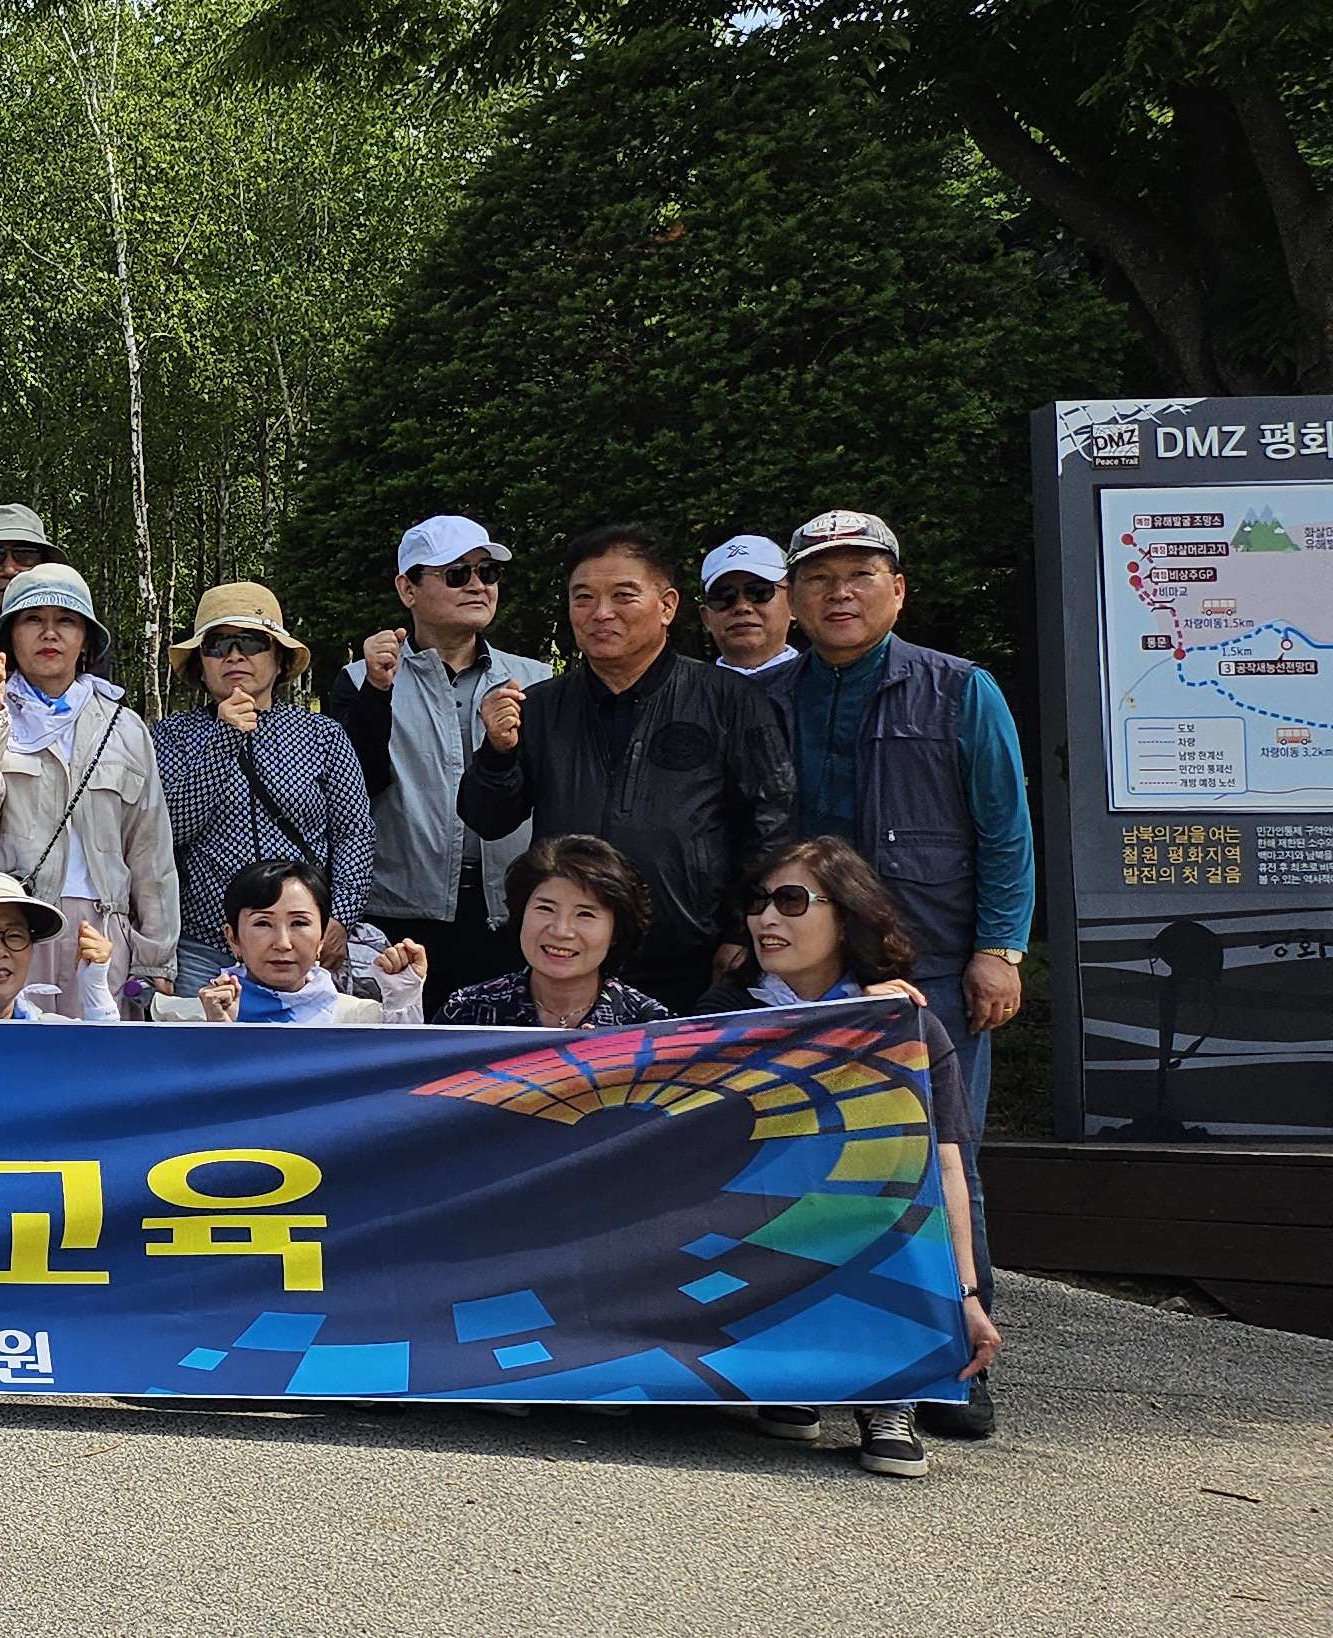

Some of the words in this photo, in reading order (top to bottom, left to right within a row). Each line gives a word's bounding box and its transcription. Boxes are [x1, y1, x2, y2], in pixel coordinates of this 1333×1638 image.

[1093, 428, 1139, 455] DMZ
[1156, 426, 1248, 458] DMZ
[1095, 457, 1119, 466] Peace
[1120, 457, 1138, 465] Trail
[1153, 515, 1191, 527] 유해발굴
[1193, 515, 1222, 526] 조망소
[1168, 544, 1227, 556] 화살머리고지
[1169, 569, 1214, 581] 비상주GP
[1146, 637, 1167, 649] 통문
[1221, 647, 1252, 657] 1.5km
[1224, 663, 1231, 673] 3
[1236, 661, 1316, 674] 공작새능선전망대
[1177, 723, 1195, 733] 도보
[1178, 737, 1196, 747] 차량
[1178, 751, 1196, 761] 남방
[1198, 751, 1224, 761] 한계선
[1260, 746, 1299, 758] 차량이동
[1178, 765, 1204, 775] 민간인
[1179, 778, 1197, 788] 개방
[1198, 778, 1216, 788] 예정
[1218, 778, 1236, 788] 노선
[1122, 825, 1170, 844] 남북의
[1173, 825, 1206, 844] 길을
[1209, 825, 1242, 843] 여는
[1304, 825, 1333, 836] 구역안
[1122, 846, 1158, 864] 철원
[1167, 846, 1241, 864] 평화지역
[1123, 866, 1175, 884] 발전의
[1182, 866, 1198, 884] 첫
[1206, 866, 1242, 884] 걸음
[1270, 874, 1280, 884] 수
[1282, 874, 1302, 884] 있는
